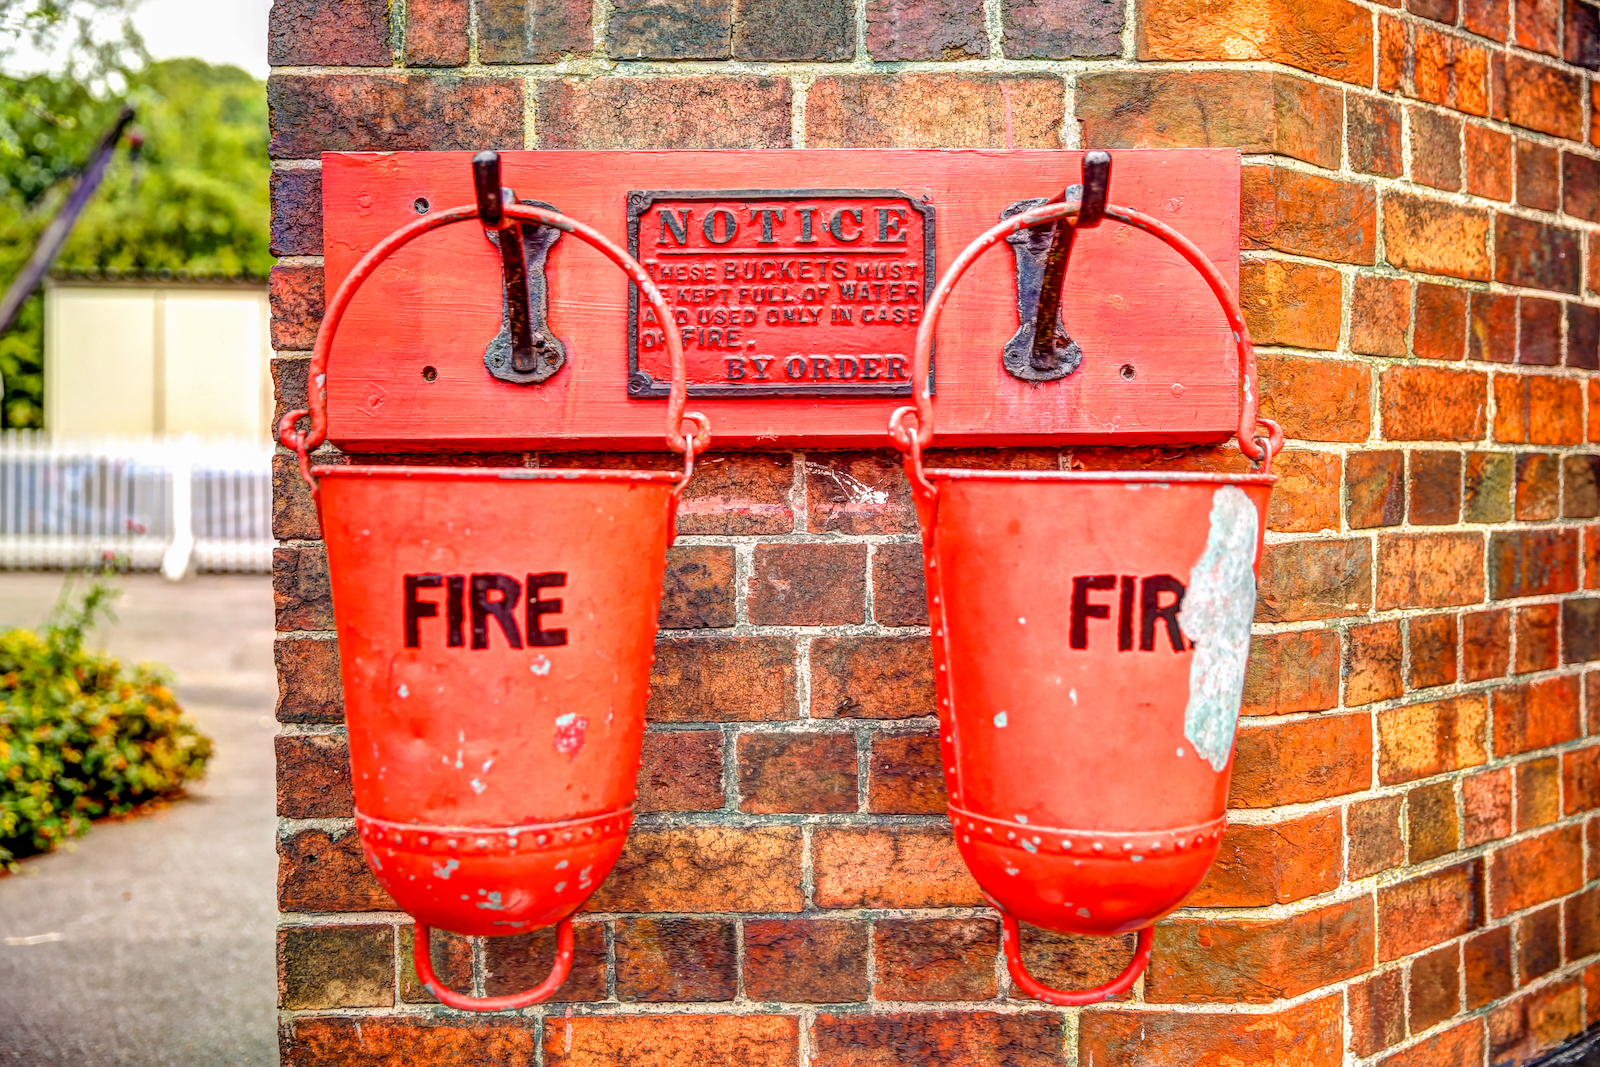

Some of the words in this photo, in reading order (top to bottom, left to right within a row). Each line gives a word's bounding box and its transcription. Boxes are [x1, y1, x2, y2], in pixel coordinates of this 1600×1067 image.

[657, 207, 907, 245] NOTICE
[645, 260, 716, 281] THESE
[724, 260, 847, 281] BUCKETS
[856, 263, 918, 280] MUST
[678, 287, 729, 303] KEPT
[739, 287, 795, 302] FULL
[803, 286, 830, 302] OF
[839, 282, 919, 301] WATER
[645, 308, 688, 325] AD
[699, 307, 756, 324] USED
[767, 307, 821, 323] ONLY
[831, 307, 852, 322] IN
[862, 306, 919, 323] CASE
[726, 356, 775, 380] BY
[786, 355, 908, 380] ORDER
[404, 573, 567, 649] FIRE
[1071, 575, 1195, 652] FIR
